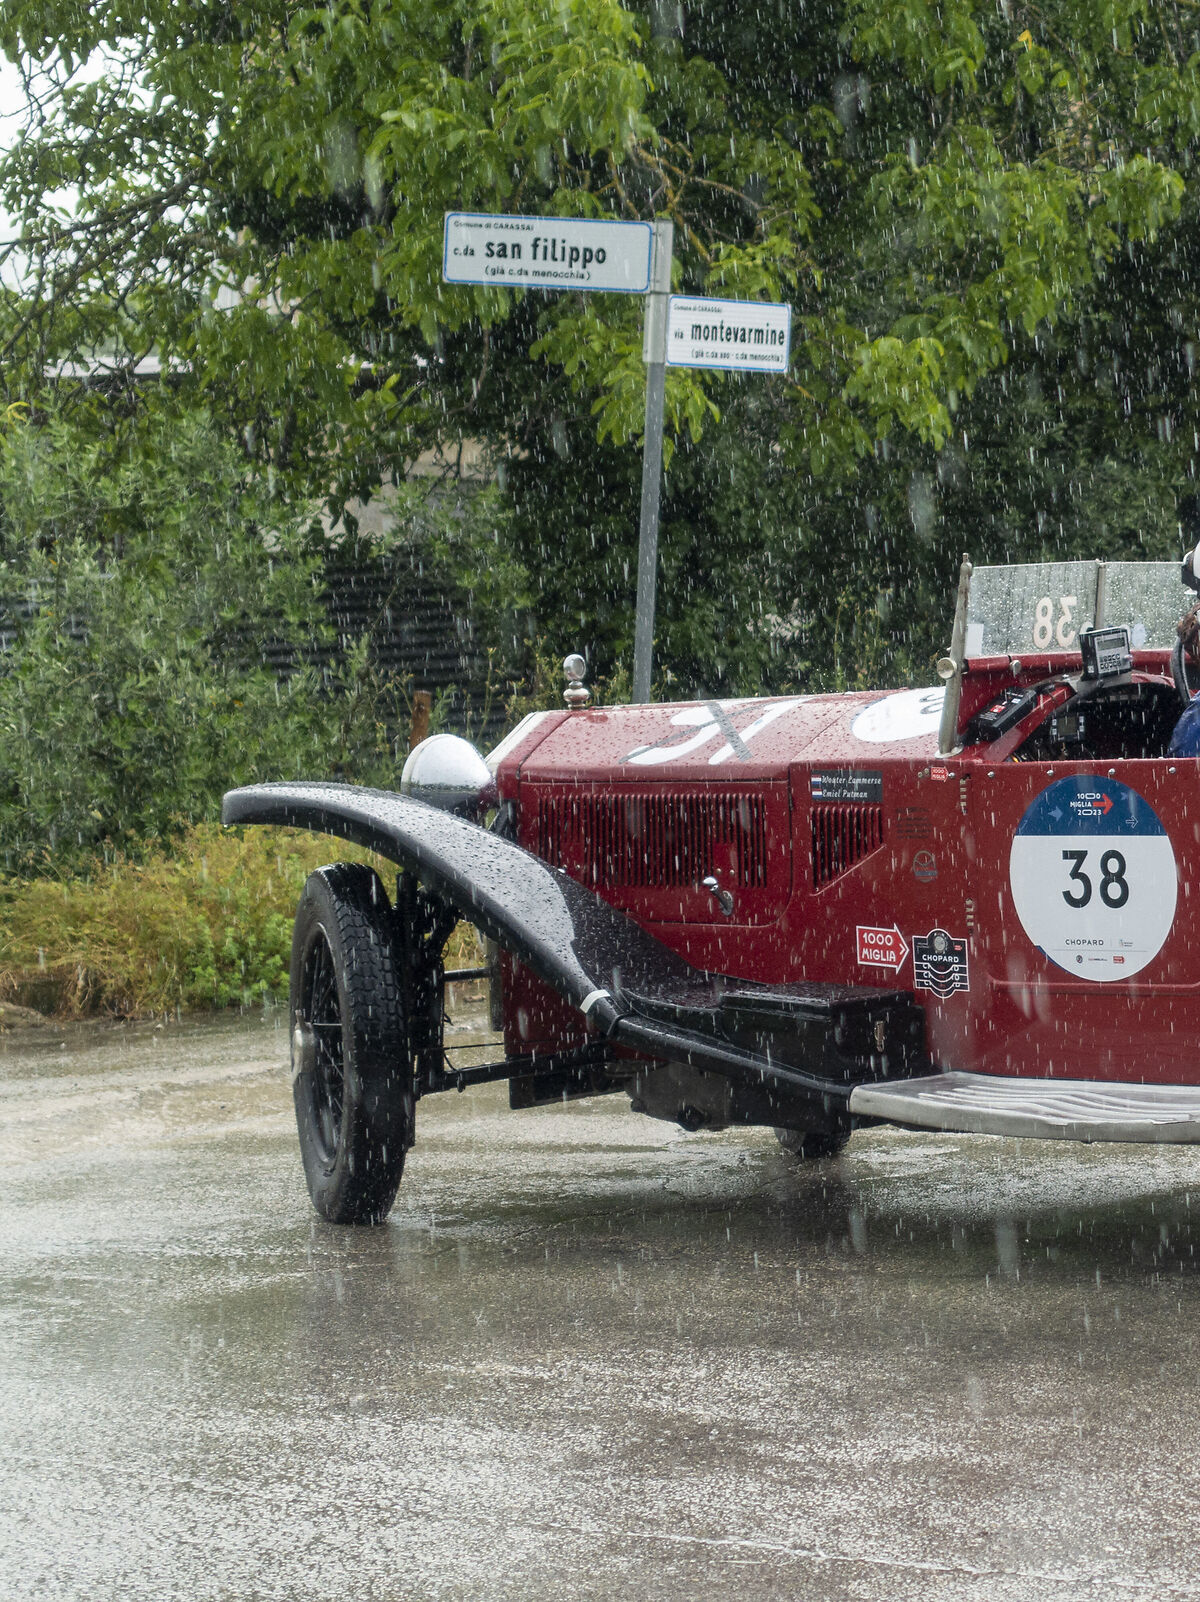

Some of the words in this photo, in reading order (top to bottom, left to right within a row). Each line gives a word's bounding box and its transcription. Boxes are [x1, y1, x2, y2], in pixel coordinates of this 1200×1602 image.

[493, 222, 535, 232] CARASSAI
[453, 245, 475, 257] c.da
[485, 239, 522, 260] san
[531, 236, 607, 269] filippo
[508, 266, 529, 277] c.da
[532, 268, 592, 281] menocchia)
[674, 328, 684, 340] via
[691, 320, 785, 346] montevarmine
[822, 789, 841, 798] Emiel
[842, 789, 868, 799] Putman
[1077, 792, 1101, 800] 1000
[1062, 849, 1129, 909] 38
[862, 931, 894, 946] 1000
[1065, 938, 1104, 946] CHOPARD
[861, 947, 896, 962] MIGLIA
[922, 954, 959, 963] CHOPARD
